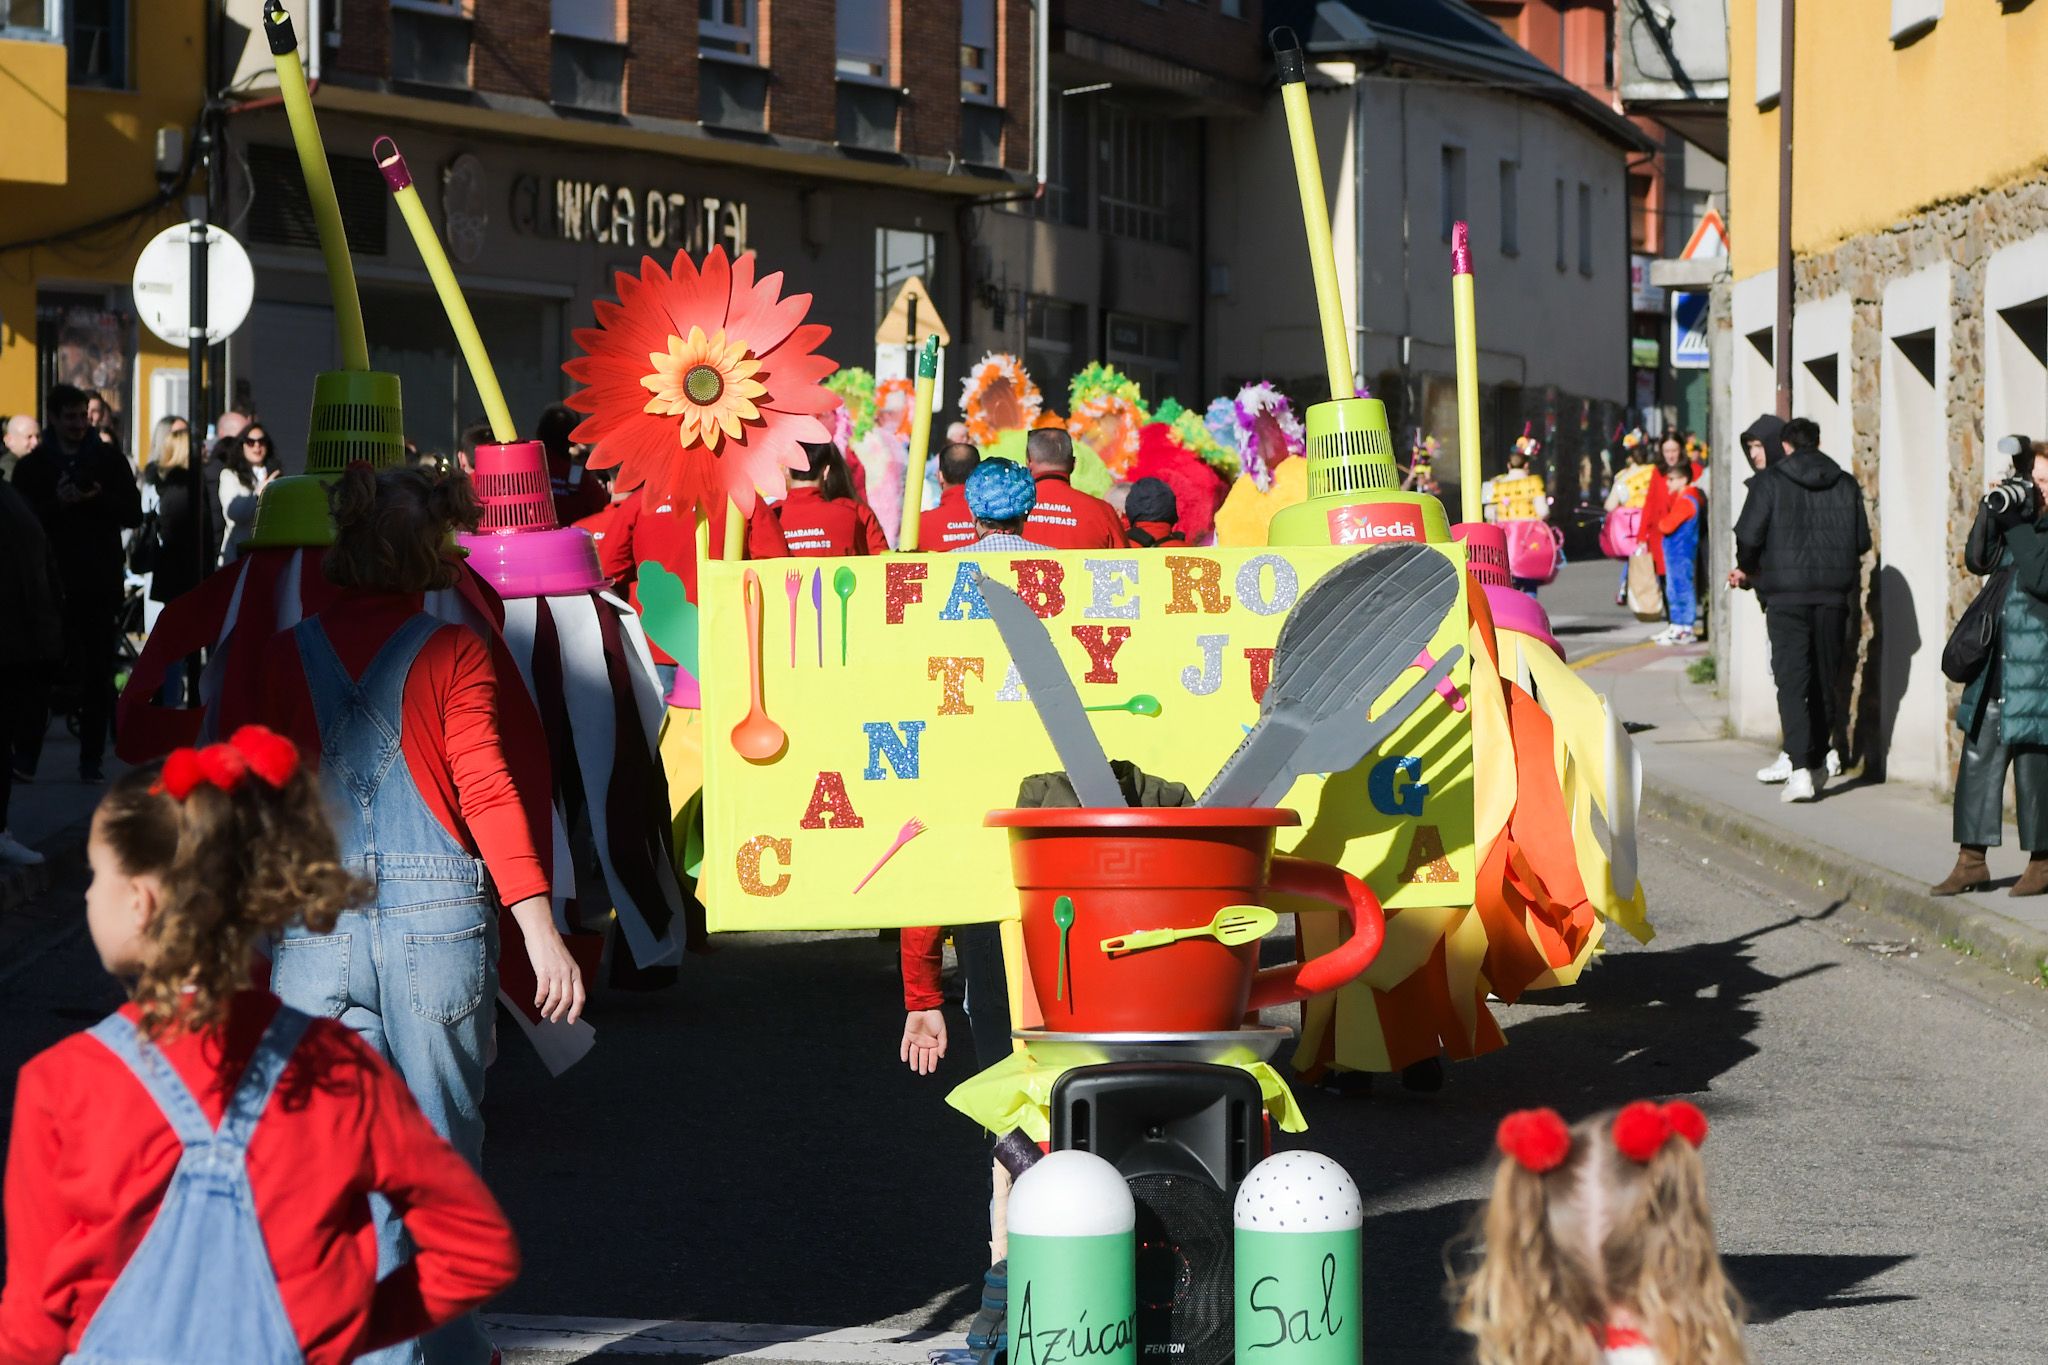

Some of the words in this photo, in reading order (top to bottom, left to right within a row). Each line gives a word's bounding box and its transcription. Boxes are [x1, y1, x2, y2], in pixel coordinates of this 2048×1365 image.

[1033, 502, 1072, 513] HARANGA
[1341, 521, 1416, 542] vileda
[885, 553, 1299, 625] FABERO
[1071, 624, 1132, 684] Y
[1013, 1279, 1136, 1365] Azúcar
[1248, 1252, 1343, 1351] Sal
[1144, 1342, 1186, 1354] FENTON
